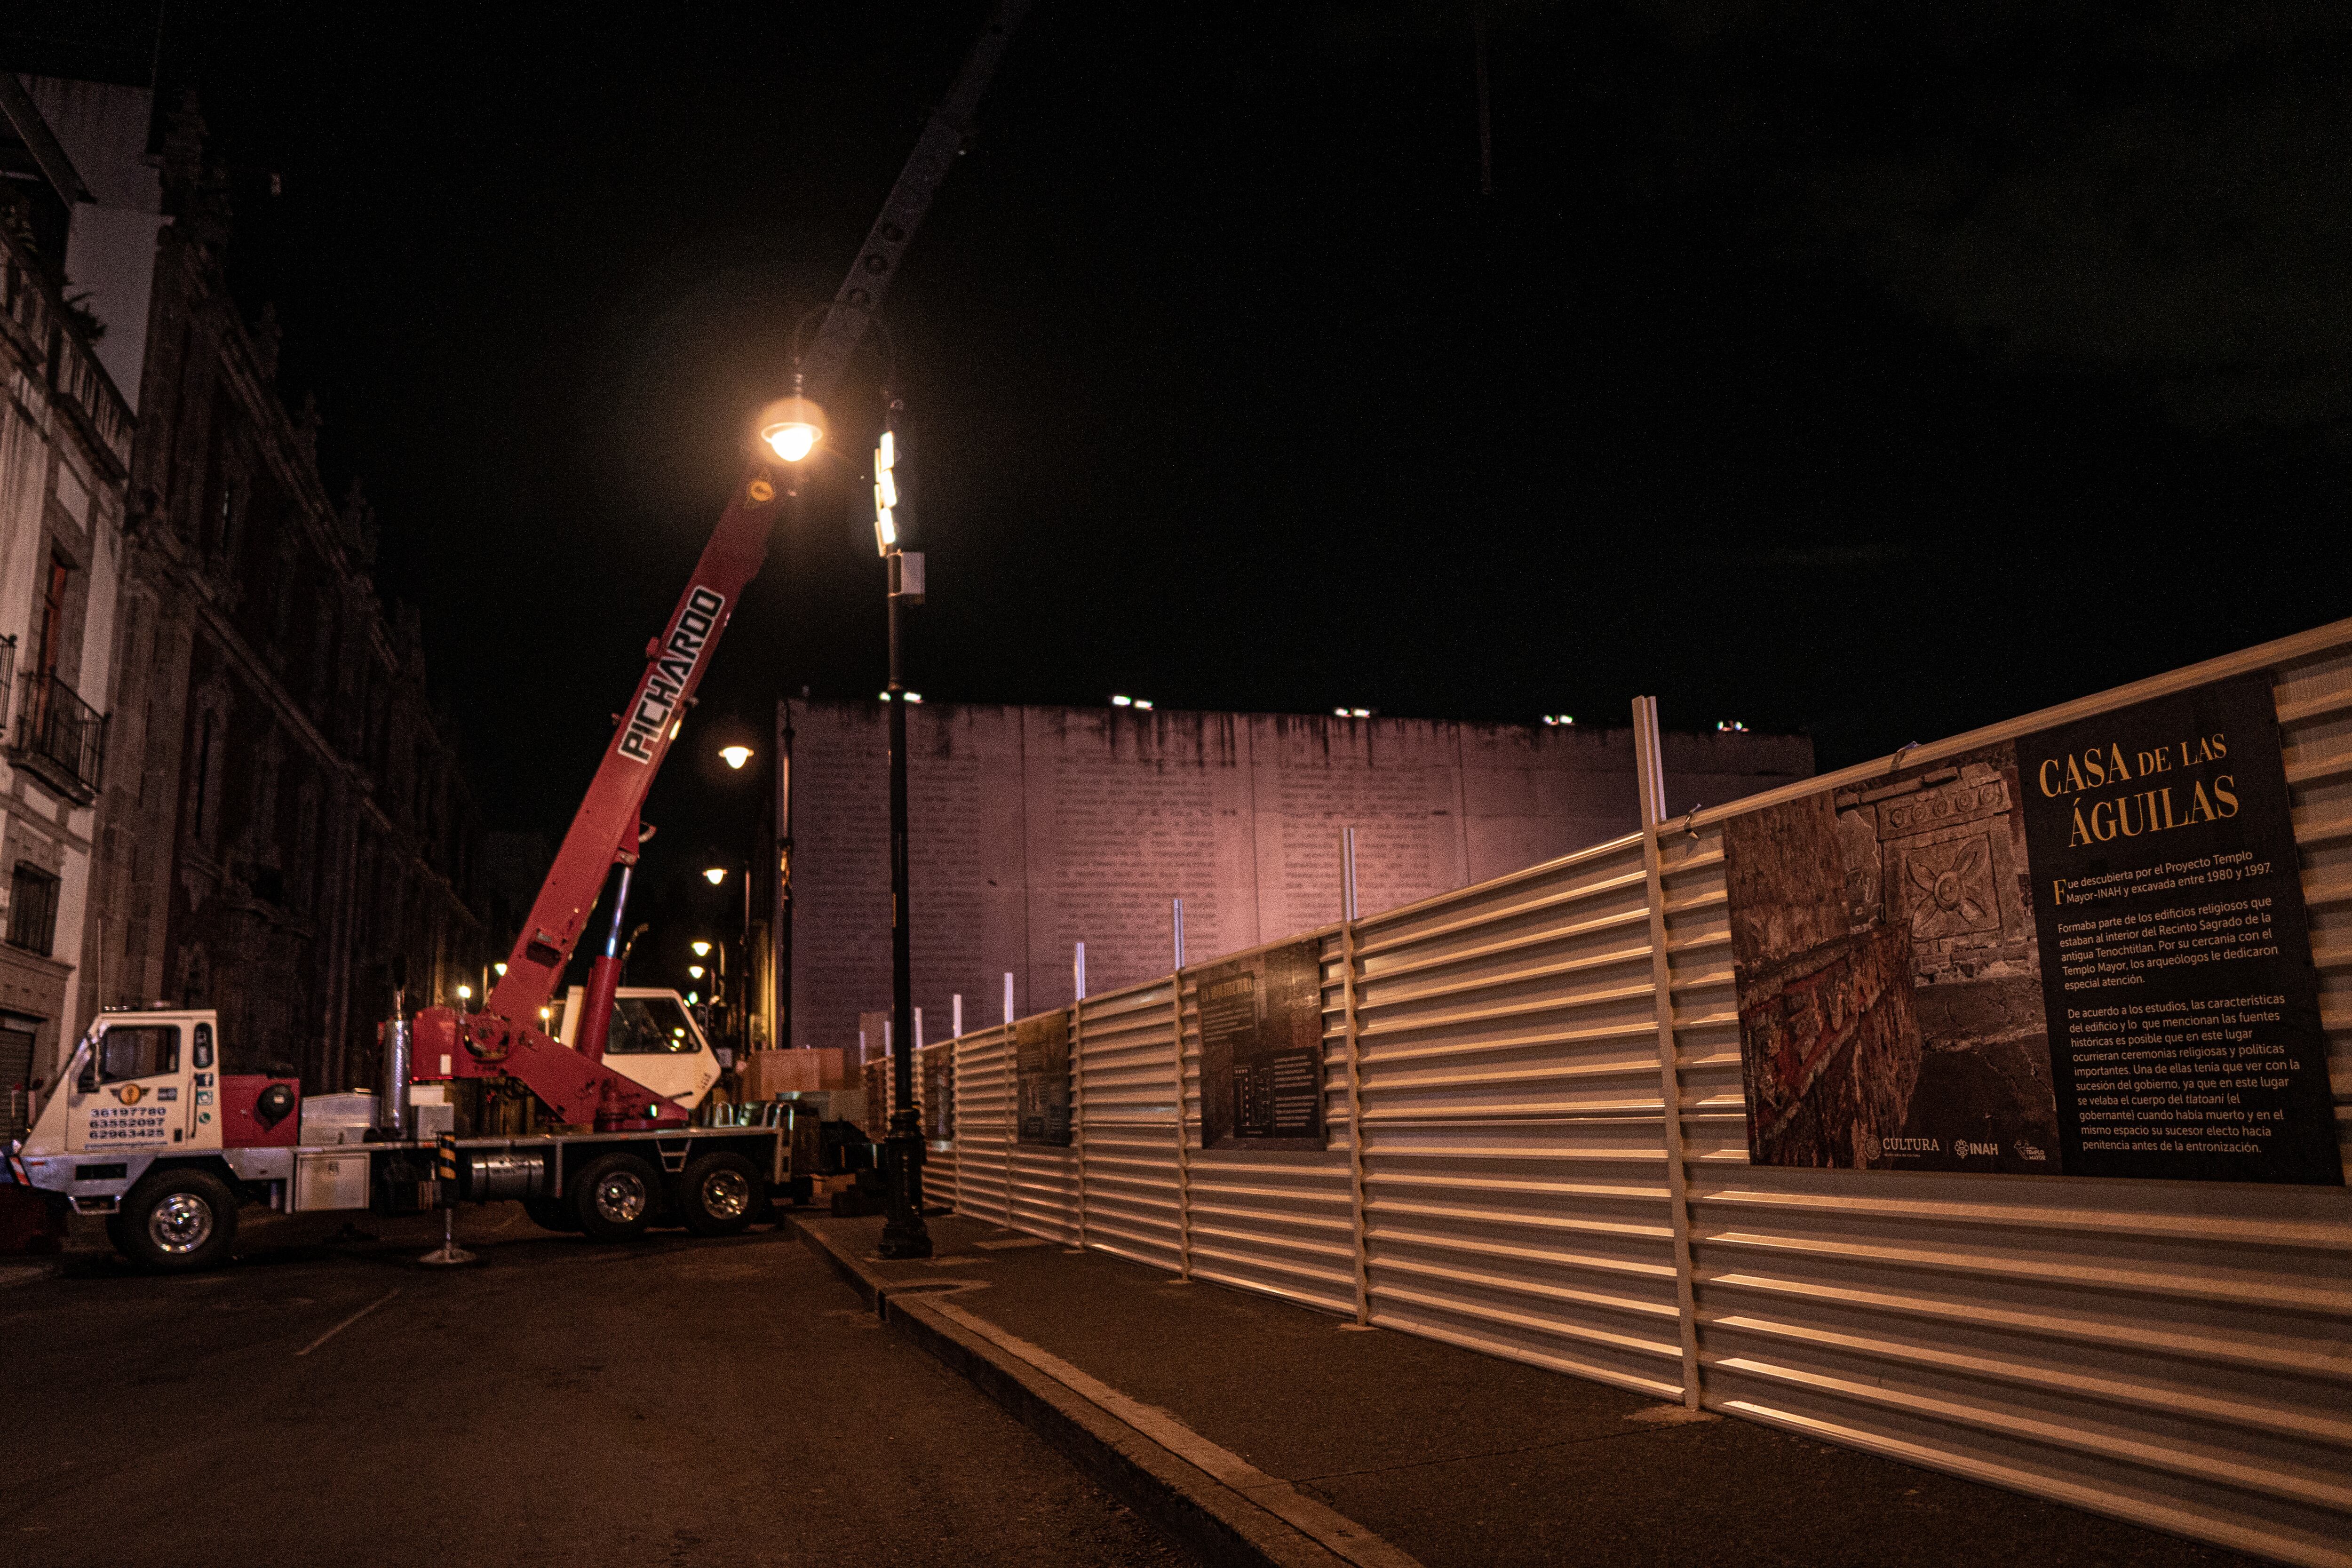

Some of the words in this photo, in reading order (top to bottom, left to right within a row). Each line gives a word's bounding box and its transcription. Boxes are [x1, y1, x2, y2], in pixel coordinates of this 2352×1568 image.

[618, 585, 725, 764] PICHARDO
[2040, 742, 2131, 797] CASA
[2137, 747, 2172, 777] DE
[2180, 733, 2227, 766] LAS
[2069, 775, 2239, 847] ÁGUILAS
[2080, 870, 2134, 887] descubierta
[2135, 868, 2152, 881] por
[2154, 864, 2164, 875] el
[2165, 858, 2211, 874] Proyecto
[2214, 851, 2253, 866] Templo
[2066, 886, 2122, 904] Mayor-INAH
[2123, 887, 2129, 898] y
[2131, 879, 2176, 894] excavada
[2178, 875, 2205, 887] entre
[2207, 869, 2233, 883] 1980
[2235, 870, 2242, 881] y
[2245, 864, 2273, 877] 1997.
[2058, 919, 2097, 933] Formaba
[2098, 916, 2122, 931] parte
[2124, 915, 2136, 925] de
[2138, 913, 2153, 923] los
[2154, 907, 2196, 921] edificios
[2198, 902, 2249, 915] religiosos
[2250, 899, 2272, 911] que
[2059, 935, 2094, 947] estaban
[2096, 932, 2104, 943] al
[2106, 929, 2139, 941] interior
[2141, 926, 2157, 938] del
[2159, 922, 2197, 935] Recinto
[2199, 917, 2242, 931] Sagrado
[2245, 915, 2259, 925] de
[2261, 913, 2272, 923] la
[2061, 950, 2094, 962] antigua
[2095, 943, 2156, 958] Tenochtitlan.
[2158, 941, 2175, 951] Por
[2177, 940, 2190, 949] su
[2192, 934, 2236, 947] cercanía
[2238, 933, 2259, 943] con
[2262, 930, 2273, 940] el
[2062, 963, 2096, 976] Templo
[2098, 961, 2129, 973] Mayor,
[2130, 959, 2145, 969] los
[2146, 954, 2209, 968] arqueólogos
[2211, 951, 2221, 961] le
[2223, 947, 2279, 960] dedicaron
[2064, 978, 2100, 992] especial
[2102, 974, 2145, 987] atención.
[2067, 1008, 2081, 1019] De
[2082, 1006, 2120, 1018] acuerdo
[2129, 1004, 2143, 1014] los
[2145, 1002, 2189, 1013] estudios,
[2191, 1000, 2205, 1010] las
[2207, 995, 2285, 1009] características
[2069, 1022, 2083, 1033] del
[2084, 1021, 2119, 1032] edificio
[2120, 1022, 2126, 1032] y
[2127, 1019, 2137, 1029] lo
[2142, 1020, 2161, 1031] que
[2162, 1016, 2219, 1027] mencionan
[2221, 1014, 2237, 1024] las
[2239, 1011, 2280, 1023] fuentes
[2071, 1036, 2114, 1047] históricas
[2128, 1033, 2162, 1047] posible
[2164, 1035, 2183, 1045] que
[2201, 1031, 2223, 1041] este
[2225, 1030, 2253, 1042] lugar
[2073, 1051, 2119, 1061] ocurrieran
[2121, 1048, 2177, 1059] ceremonias
[2179, 1047, 2227, 1059] religiosas
[2229, 1048, 2236, 1058] y
[2238, 1045, 2285, 1058] políticas
[2074, 1065, 2131, 1078] importantes.
[2133, 1064, 2153, 1074] Una
[2154, 1064, 2167, 1074] de
[2169, 1063, 2192, 1073] ellas
[2194, 1062, 2220, 1072] tenía
[2222, 1064, 2243, 1074] que
[2289, 1060, 2300, 1070] la
[2075, 1080, 2115, 1090] sucesión
[2117, 1080, 2132, 1090] del
[2133, 1079, 2180, 1091] gobierno,
[2182, 1081, 2194, 1090] ya
[2197, 1081, 2217, 1090] que
[2235, 1078, 2258, 1088] este
[2260, 1077, 2289, 1089] lugar
[2089, 1095, 2119, 1105] velaba
[2120, 1095, 2130, 1105] el
[2131, 1097, 2166, 1106] cuerpo
[2167, 1094, 2184, 1104] del
[2185, 1094, 2224, 1104] tlatoani
[2227, 1094, 2241, 1106] (el
[90, 1107, 166, 1118] 36197780
[2079, 1110, 2135, 1122] gobernante)
[2137, 1110, 2174, 1120] cuando
[2206, 1110, 2245, 1120] muerto
[2247, 1113, 2254, 1122] y
[2273, 1110, 2284, 1120] el
[2081, 1125, 2112, 1135] mismo
[2113, 1125, 2150, 1137] espacio
[2206, 1126, 2240, 1136] electo
[1883, 1138, 1940, 1151] CULTURA
[1970, 1143, 1999, 1155] INAH
[2082, 1140, 2130, 1152] penitencia
[2132, 1141, 2158, 1151] antes
[2160, 1141, 2172, 1151] de
[2174, 1141, 2184, 1151] la
[2185, 1142, 2262, 1152] entronización.
